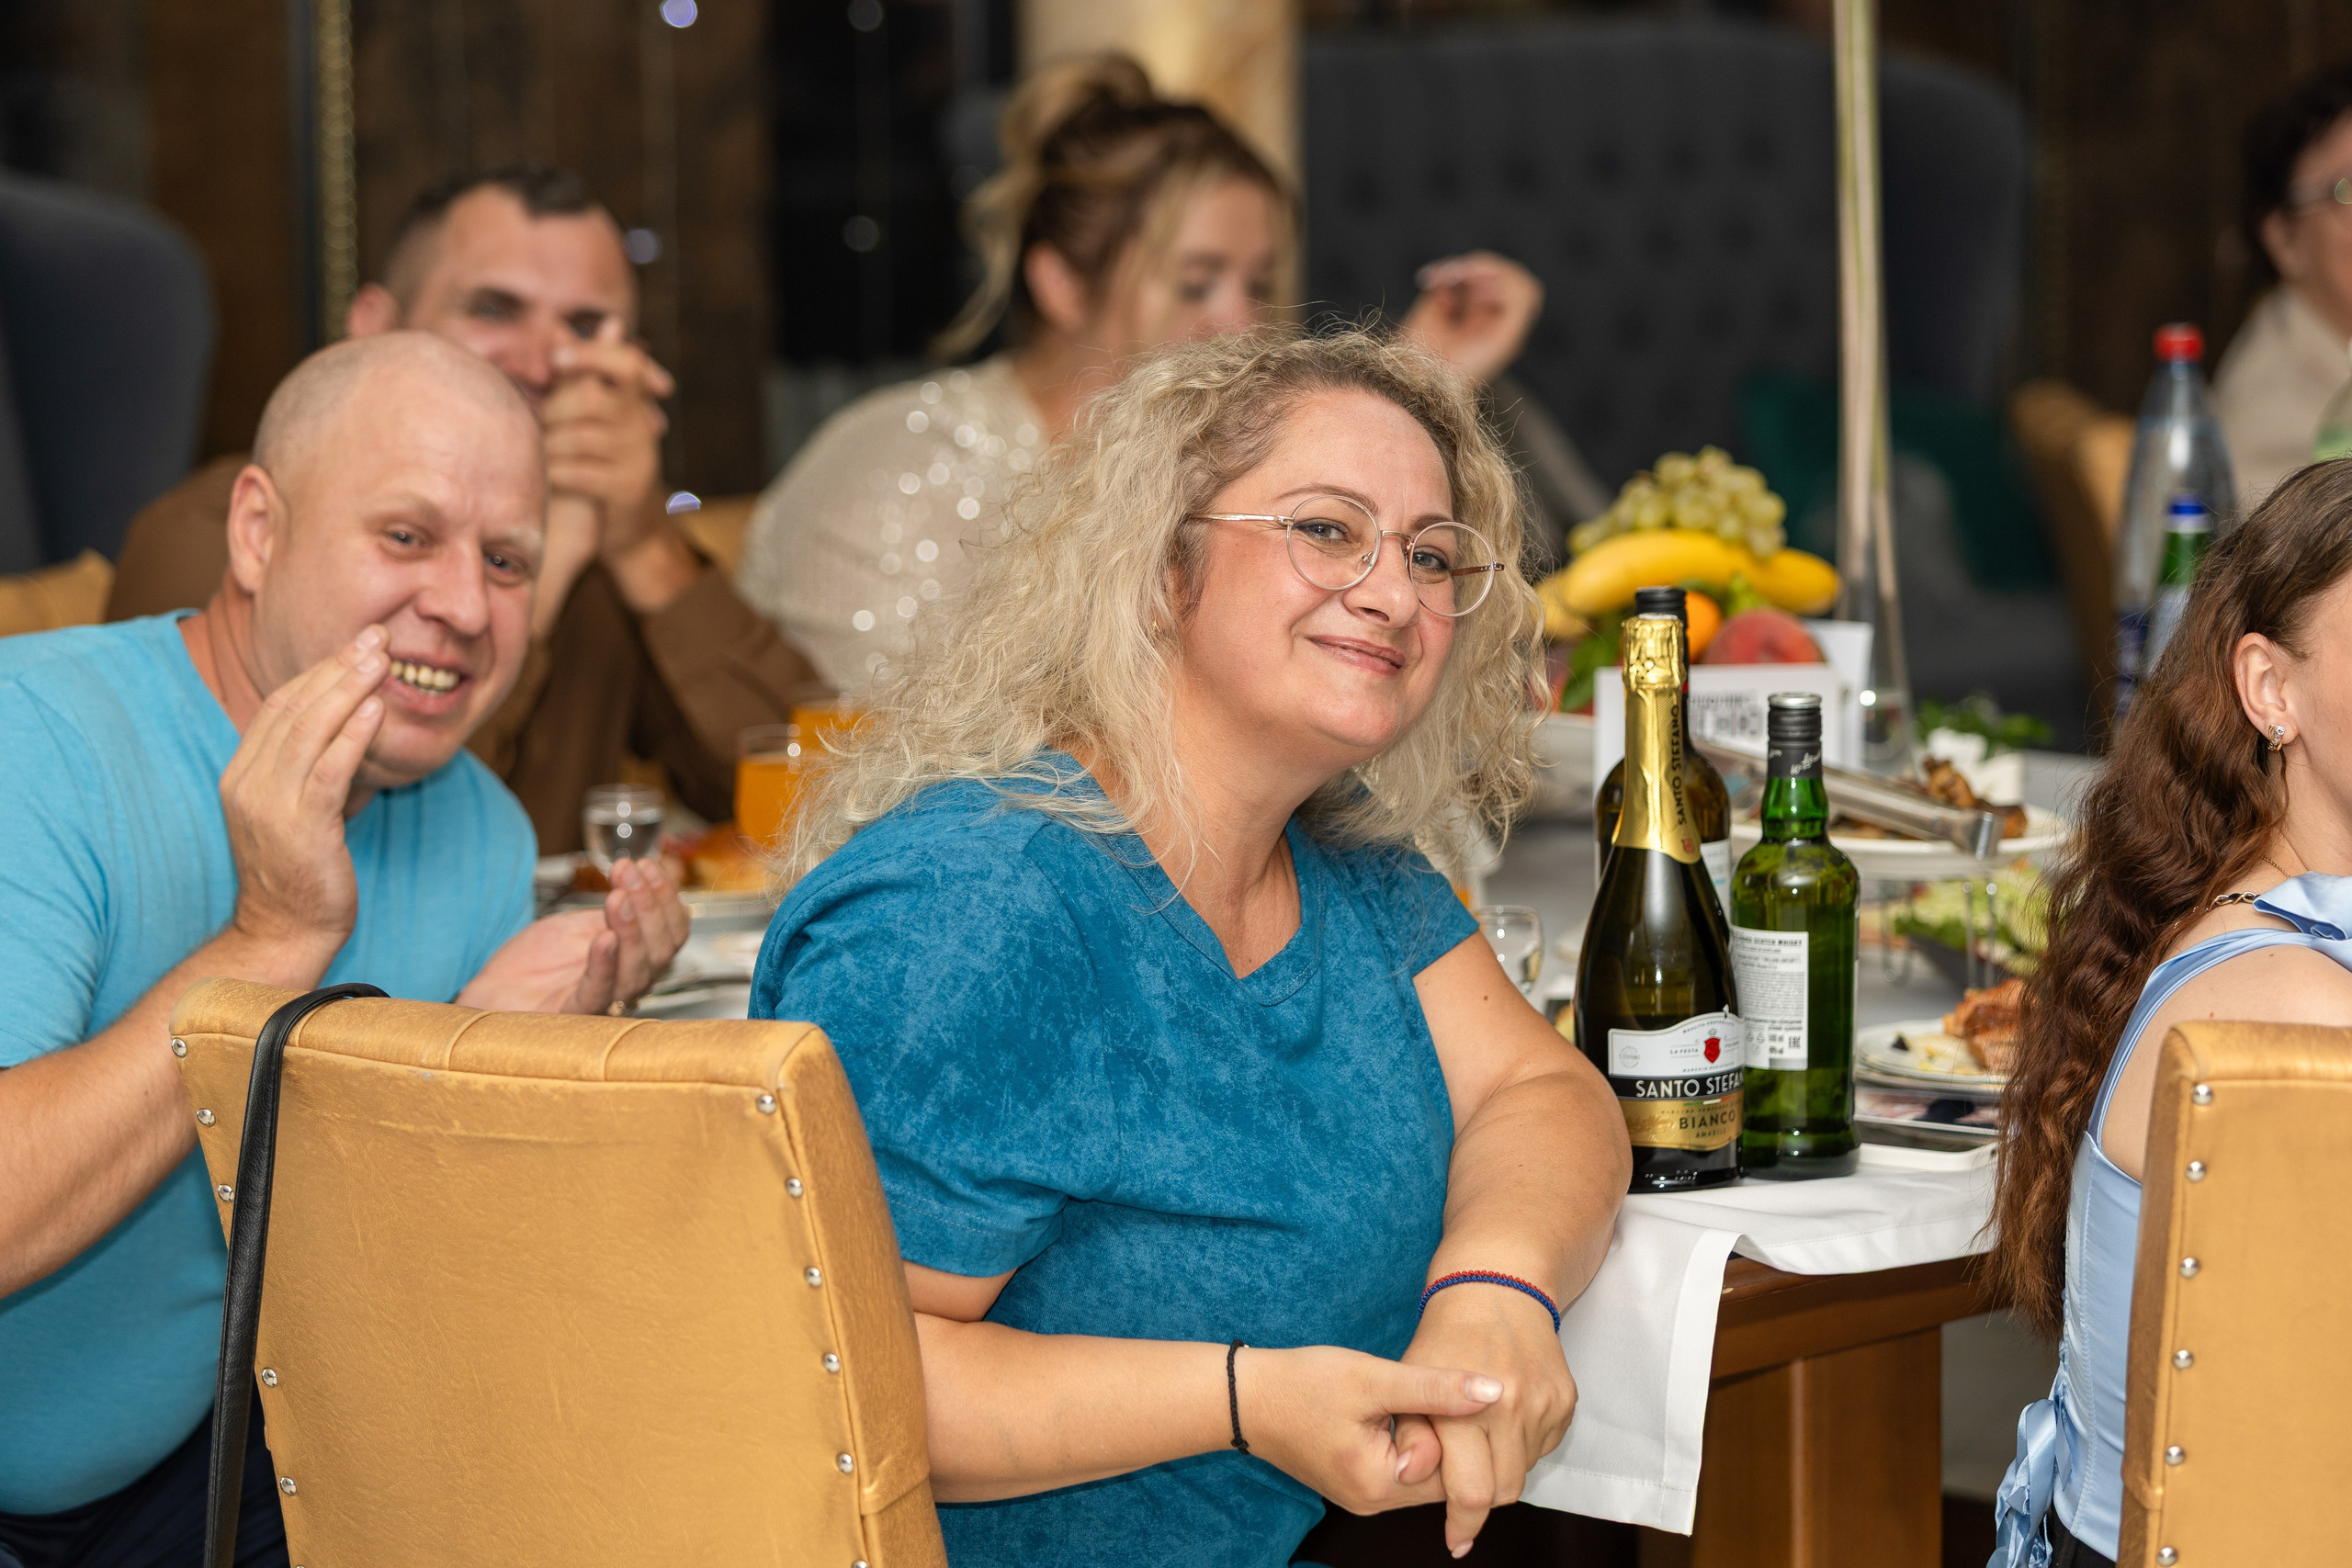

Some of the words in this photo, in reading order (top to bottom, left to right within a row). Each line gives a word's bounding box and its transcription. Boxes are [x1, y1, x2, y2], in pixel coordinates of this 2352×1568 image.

[1671, 704, 1682, 772] STEFANO
[1672, 775, 1687, 826] SANTO
[1635, 1078, 1700, 1099] SANTO
[1679, 1109, 1736, 1130] BIANCO
